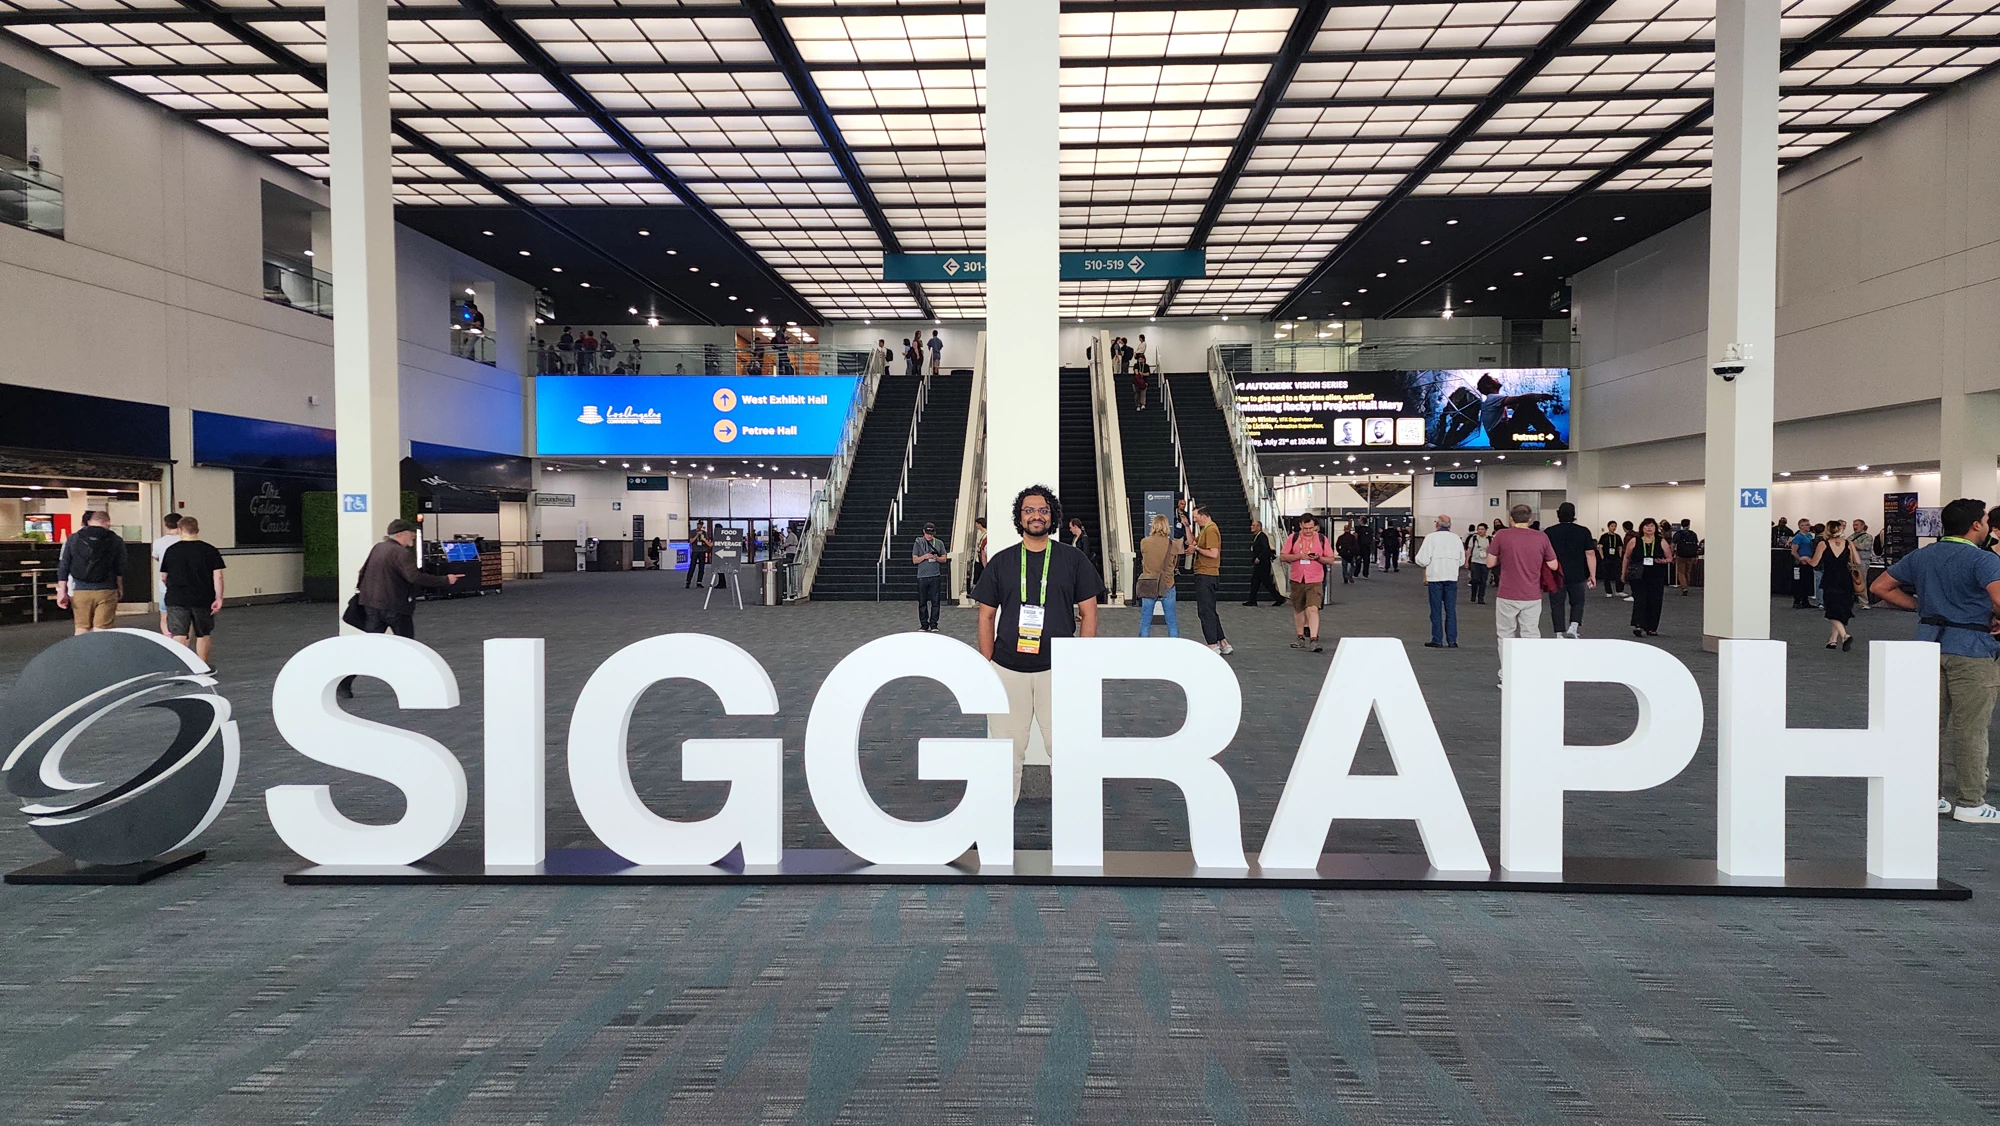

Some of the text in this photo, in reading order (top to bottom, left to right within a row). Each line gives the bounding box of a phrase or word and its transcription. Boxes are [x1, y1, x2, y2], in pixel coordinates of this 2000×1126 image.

[963, 261, 986, 272] 301-
[1084, 259, 1125, 271] 510-519
[1246, 381, 1348, 390] AUTODESK VISION SERIES
[741, 394, 828, 404] West Exhibit Hall
[1257, 395, 1271, 403] give
[1235, 400, 1404, 413] Animating Rocky in Project Hail Mary
[742, 425, 798, 435] Petree Hall
[1264, 438, 1278, 447] July
[1316, 437, 1327, 445] AM
[250, 496, 287, 518] Galaxy
[265, 631, 1940, 880] SIGGRAPH
